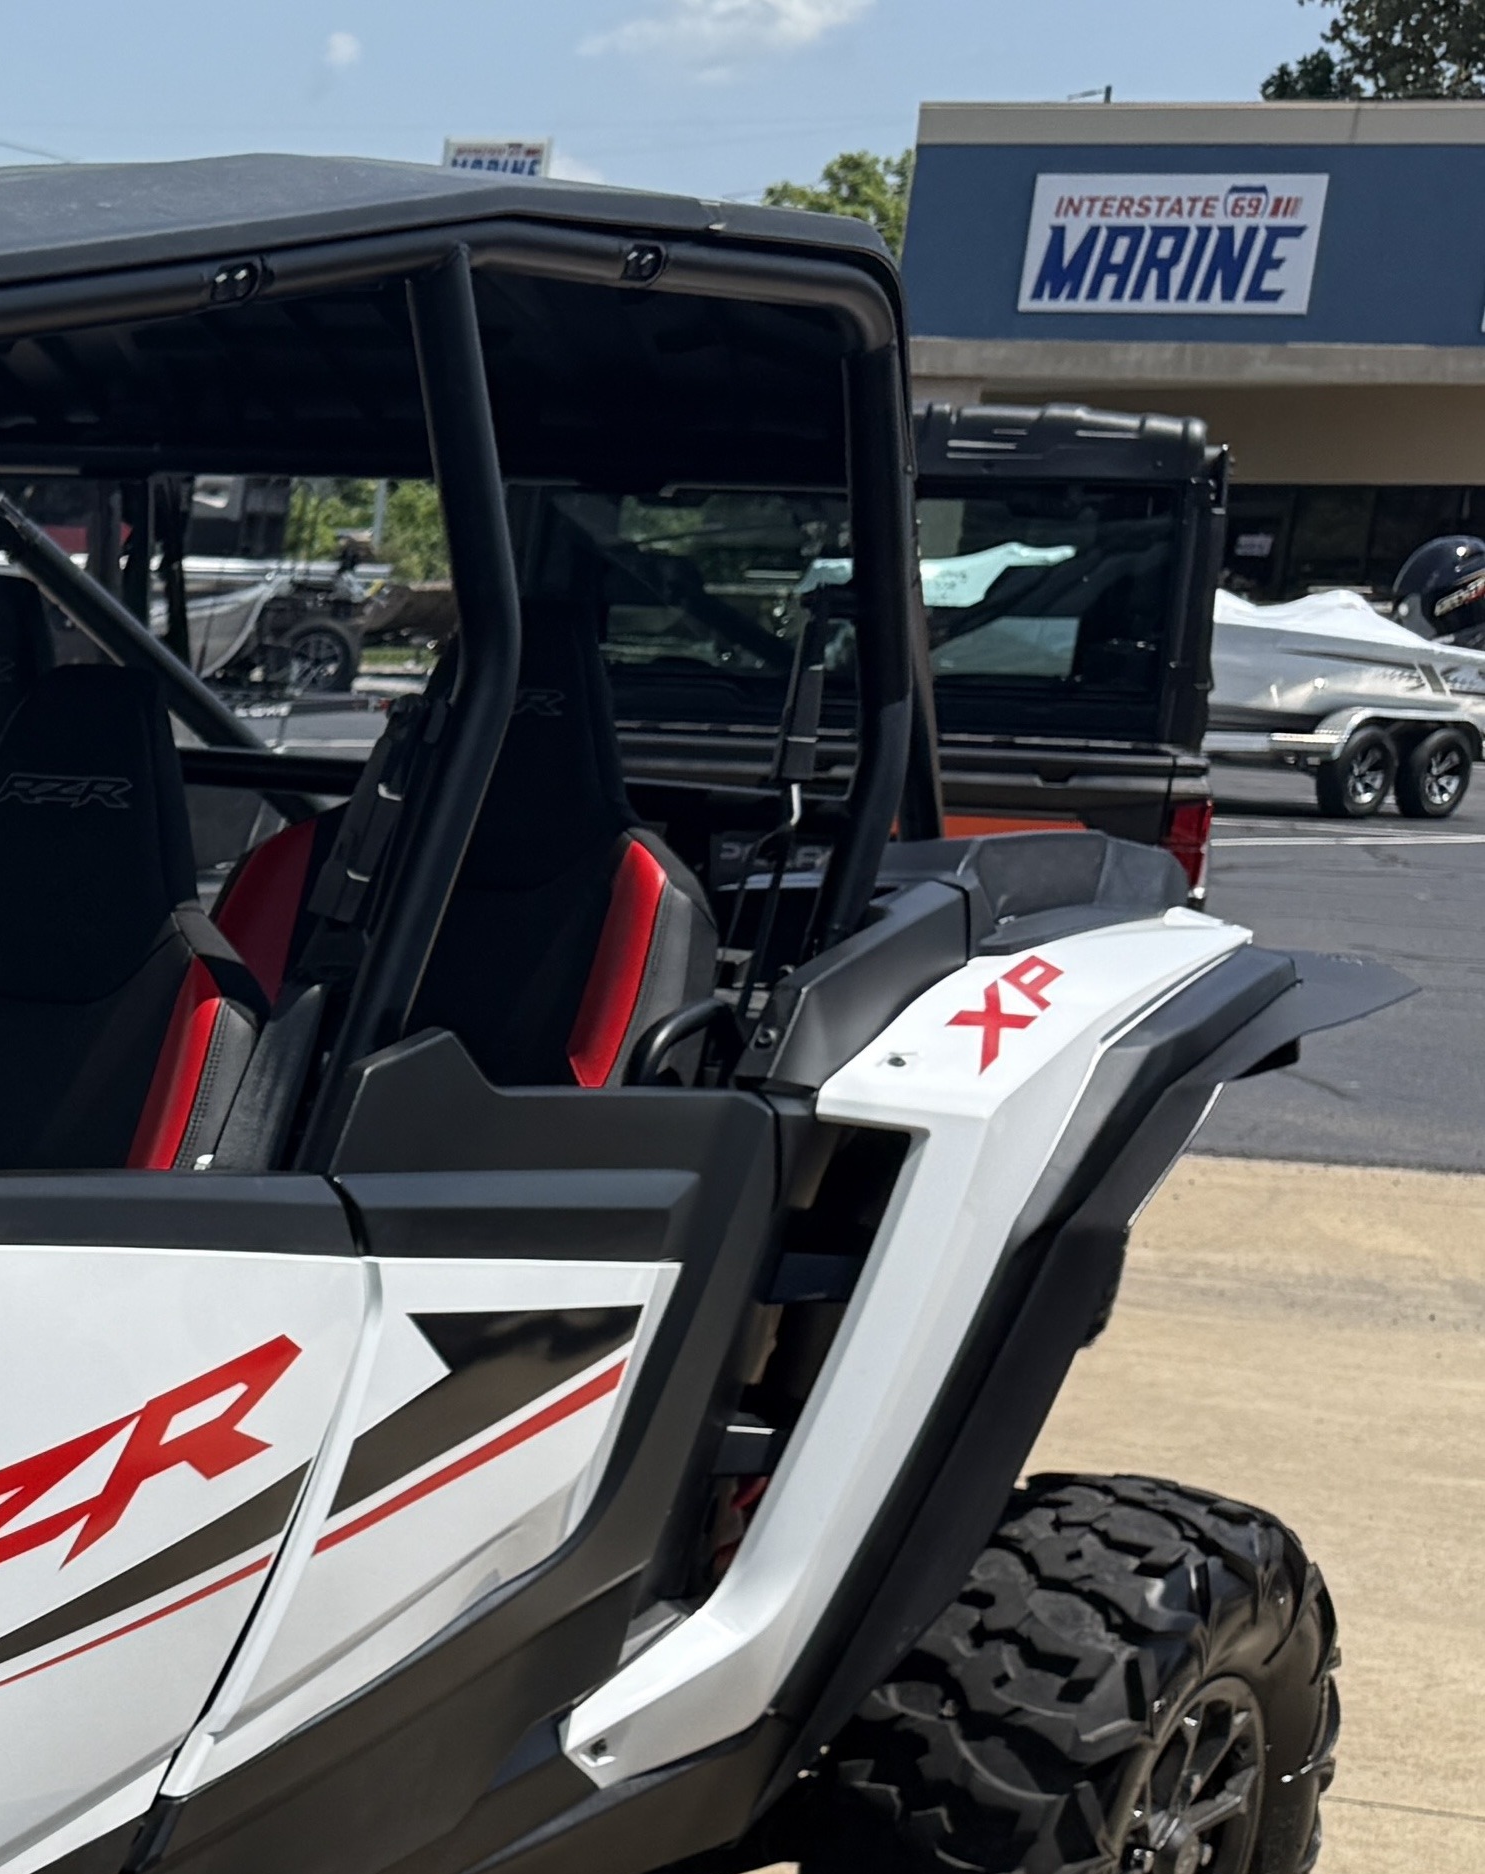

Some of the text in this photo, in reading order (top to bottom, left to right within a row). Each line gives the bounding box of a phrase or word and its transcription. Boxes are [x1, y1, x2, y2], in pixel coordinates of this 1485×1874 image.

[1054, 195, 1263, 219] INTERSTATE 69
[1031, 224, 1308, 303] MARINE
[945, 954, 1064, 1075] XP
